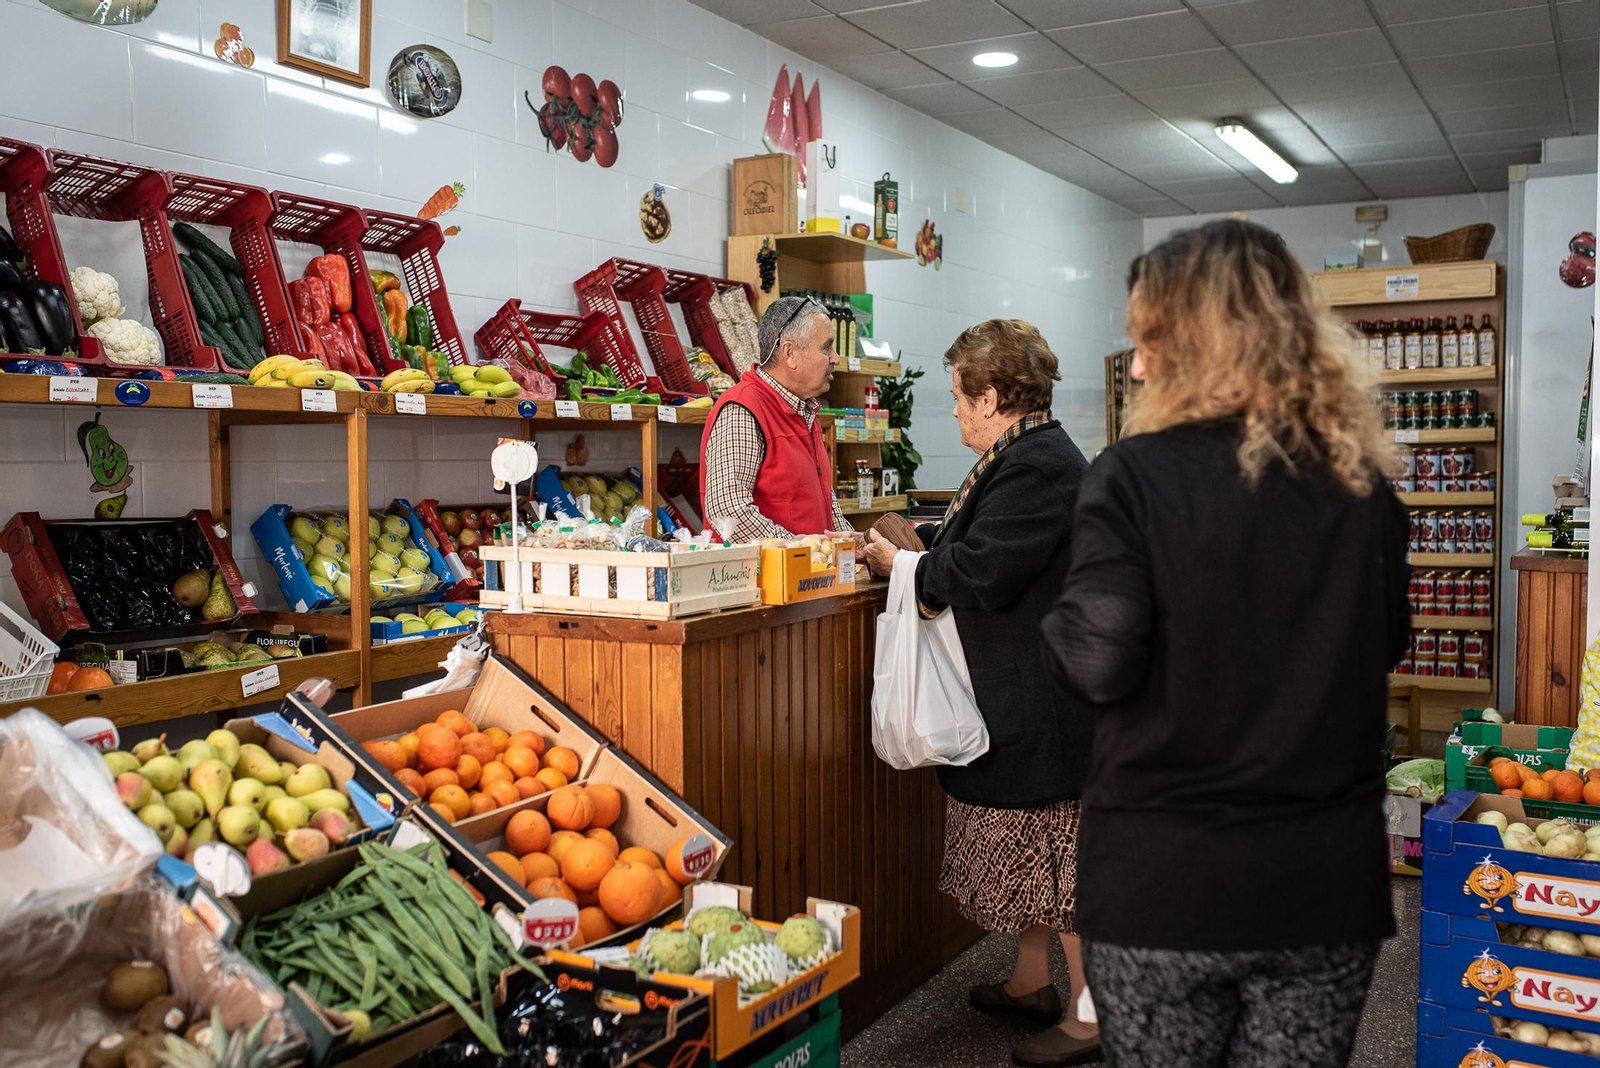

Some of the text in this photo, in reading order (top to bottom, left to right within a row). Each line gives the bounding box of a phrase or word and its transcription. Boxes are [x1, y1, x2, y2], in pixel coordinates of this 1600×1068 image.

[274, 546, 295, 580] Marlene
[798, 575, 836, 592] NOVOFRUT
[45, 597, 62, 631] PERA
[256, 637, 274, 647] FLOR
[1525, 883, 1600, 917] Nay
[750, 969, 829, 1035] NOVOFRUT
[1523, 978, 1598, 1013] Nay
